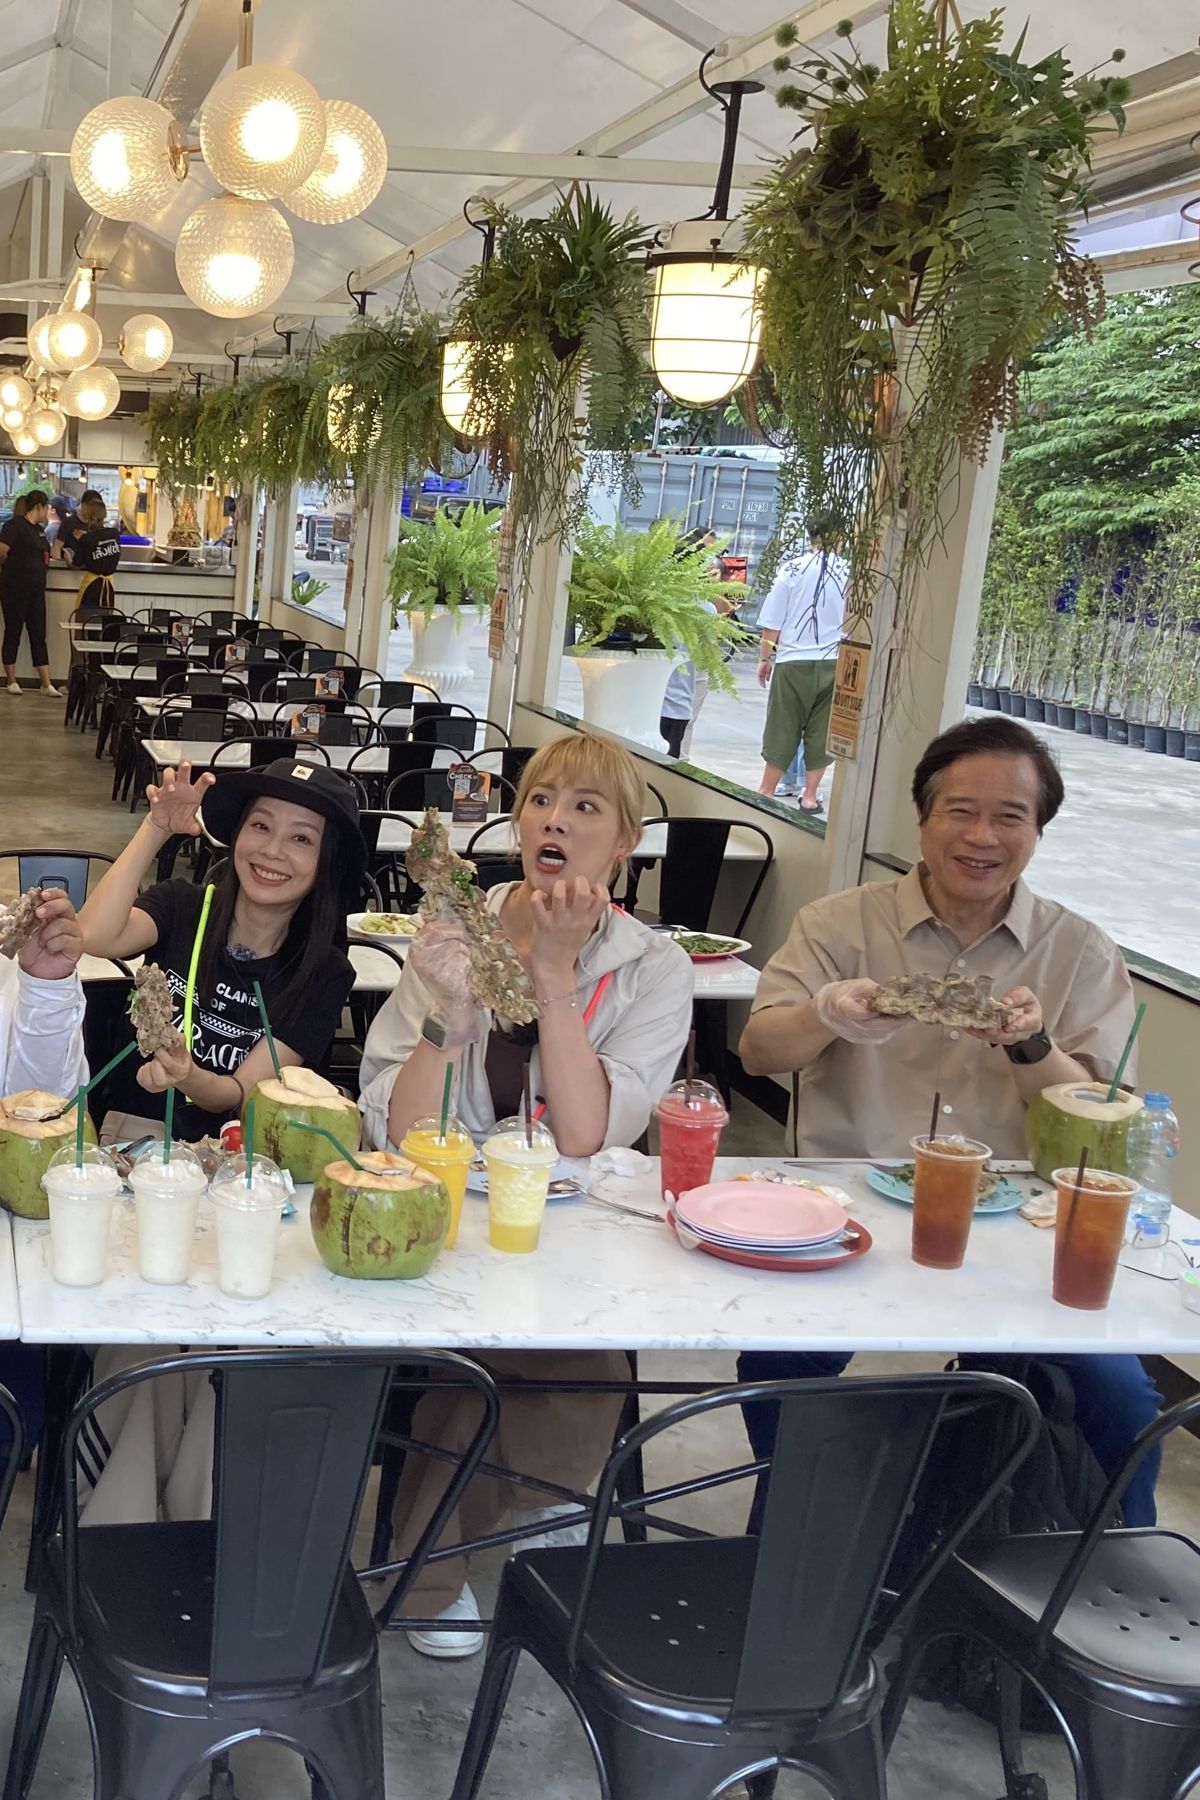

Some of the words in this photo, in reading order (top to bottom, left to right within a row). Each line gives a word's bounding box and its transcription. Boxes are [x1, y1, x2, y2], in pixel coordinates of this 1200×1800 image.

[449, 772, 473, 780] CHECK
[216, 983, 259, 1008] CLANS
[210, 998, 227, 1012] OF
